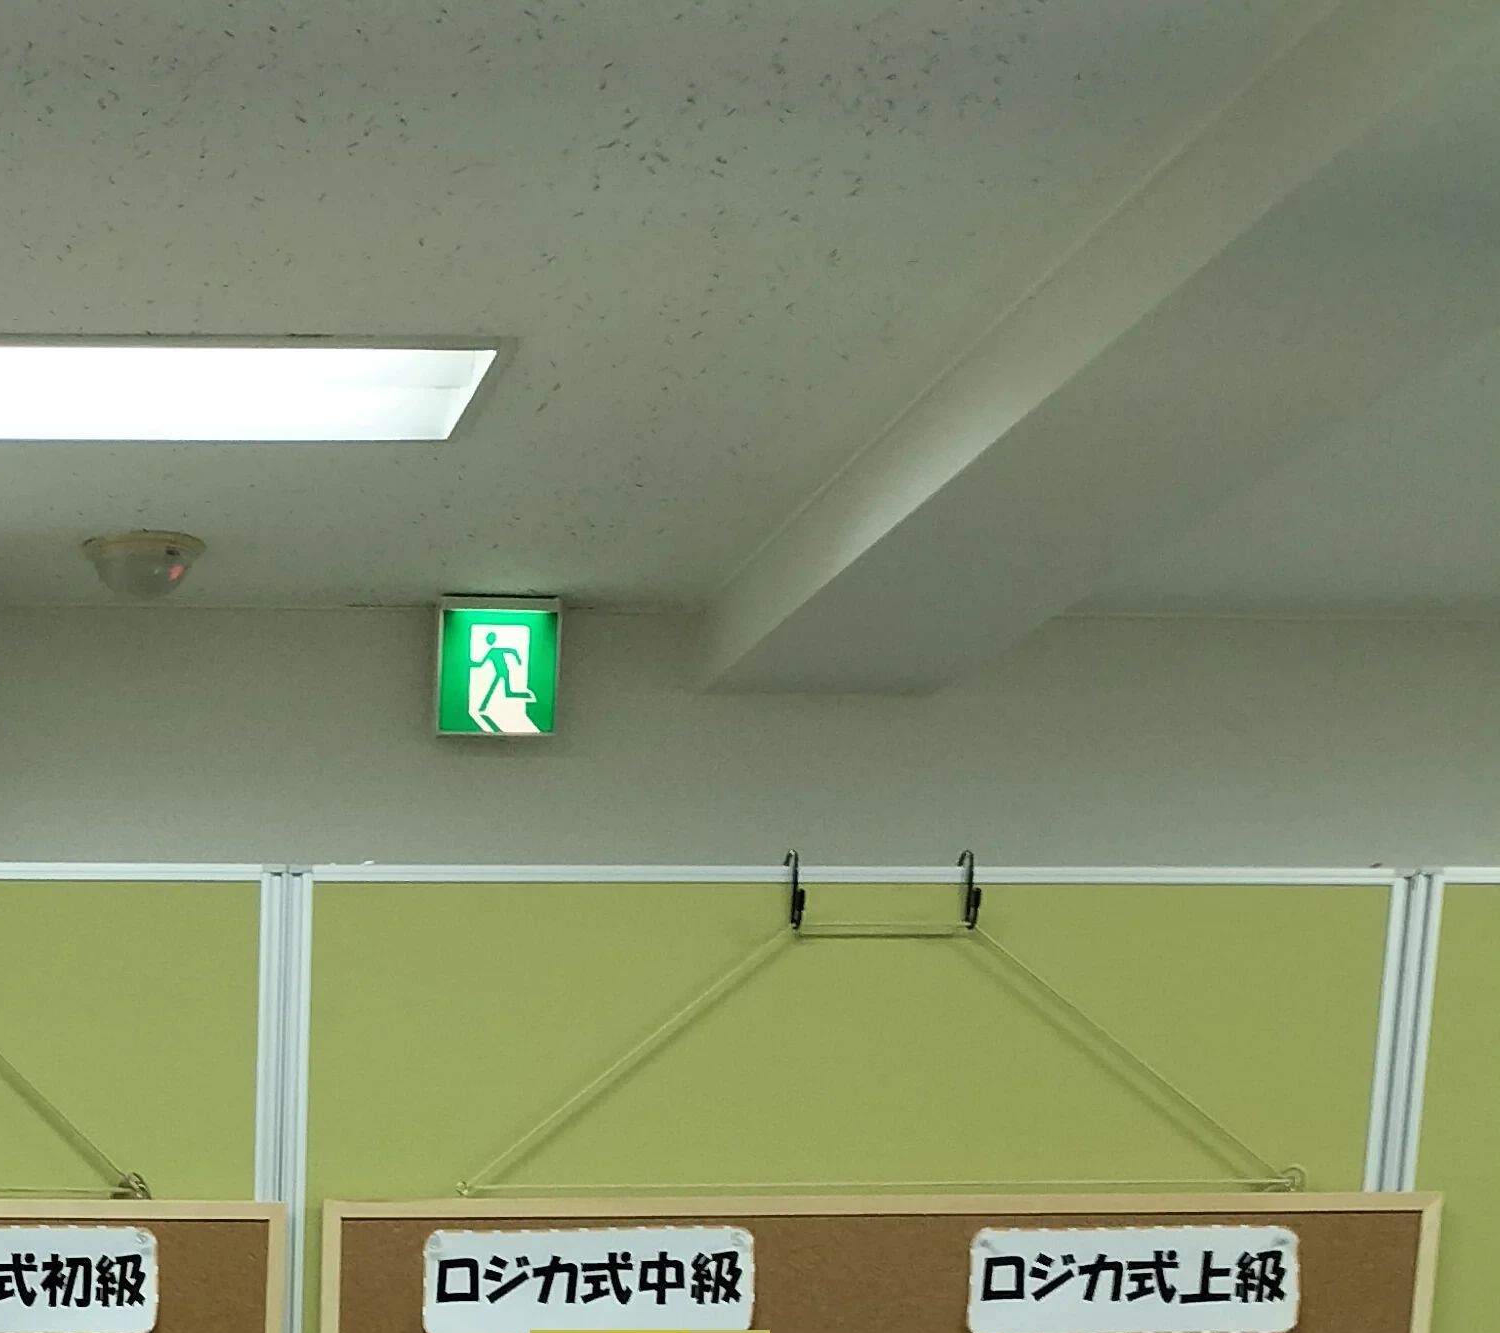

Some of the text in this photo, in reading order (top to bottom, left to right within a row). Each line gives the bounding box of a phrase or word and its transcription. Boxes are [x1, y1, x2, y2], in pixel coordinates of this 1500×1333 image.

[436, 1250, 743, 1305] ロジカ式中級
[981, 1250, 1286, 1303] ロジカ式上級
